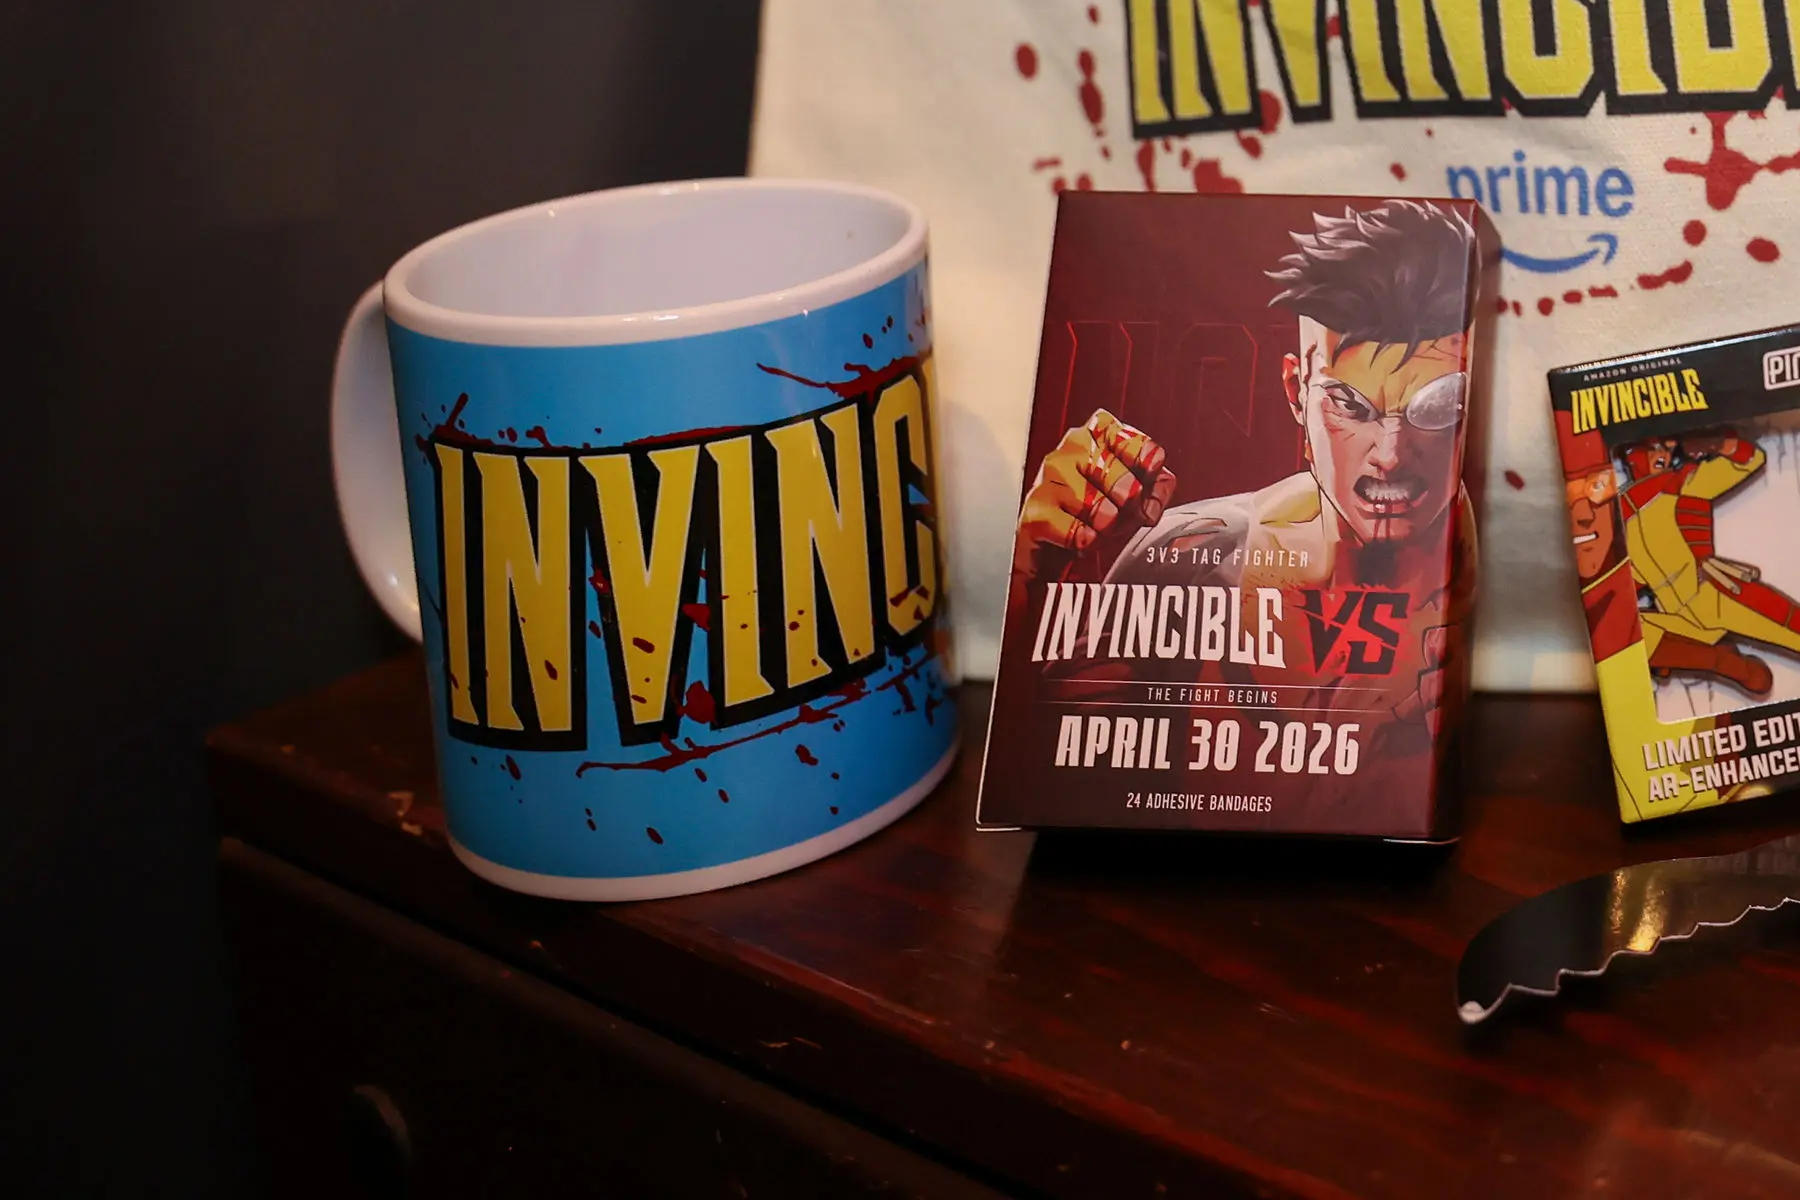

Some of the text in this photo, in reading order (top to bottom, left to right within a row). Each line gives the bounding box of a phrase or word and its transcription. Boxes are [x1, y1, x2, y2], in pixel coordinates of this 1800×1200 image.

[1582, 357, 1684, 383] AMAZON ORIGINAL
[1570, 368, 1710, 435] INVINCIBLE
[1190, 548, 1222, 566] TAG
[1232, 549, 1311, 568] FIGHTER
[1031, 582, 1411, 676] INVINCIBLE VS
[1147, 687, 1278, 704] THE FIGHT BEGINS
[1054, 715, 1361, 776] APRIL 30 2026
[1641, 723, 1748, 772] LIMITED
[1126, 792, 1273, 813] 24 ADHESIVE BANDAGES
